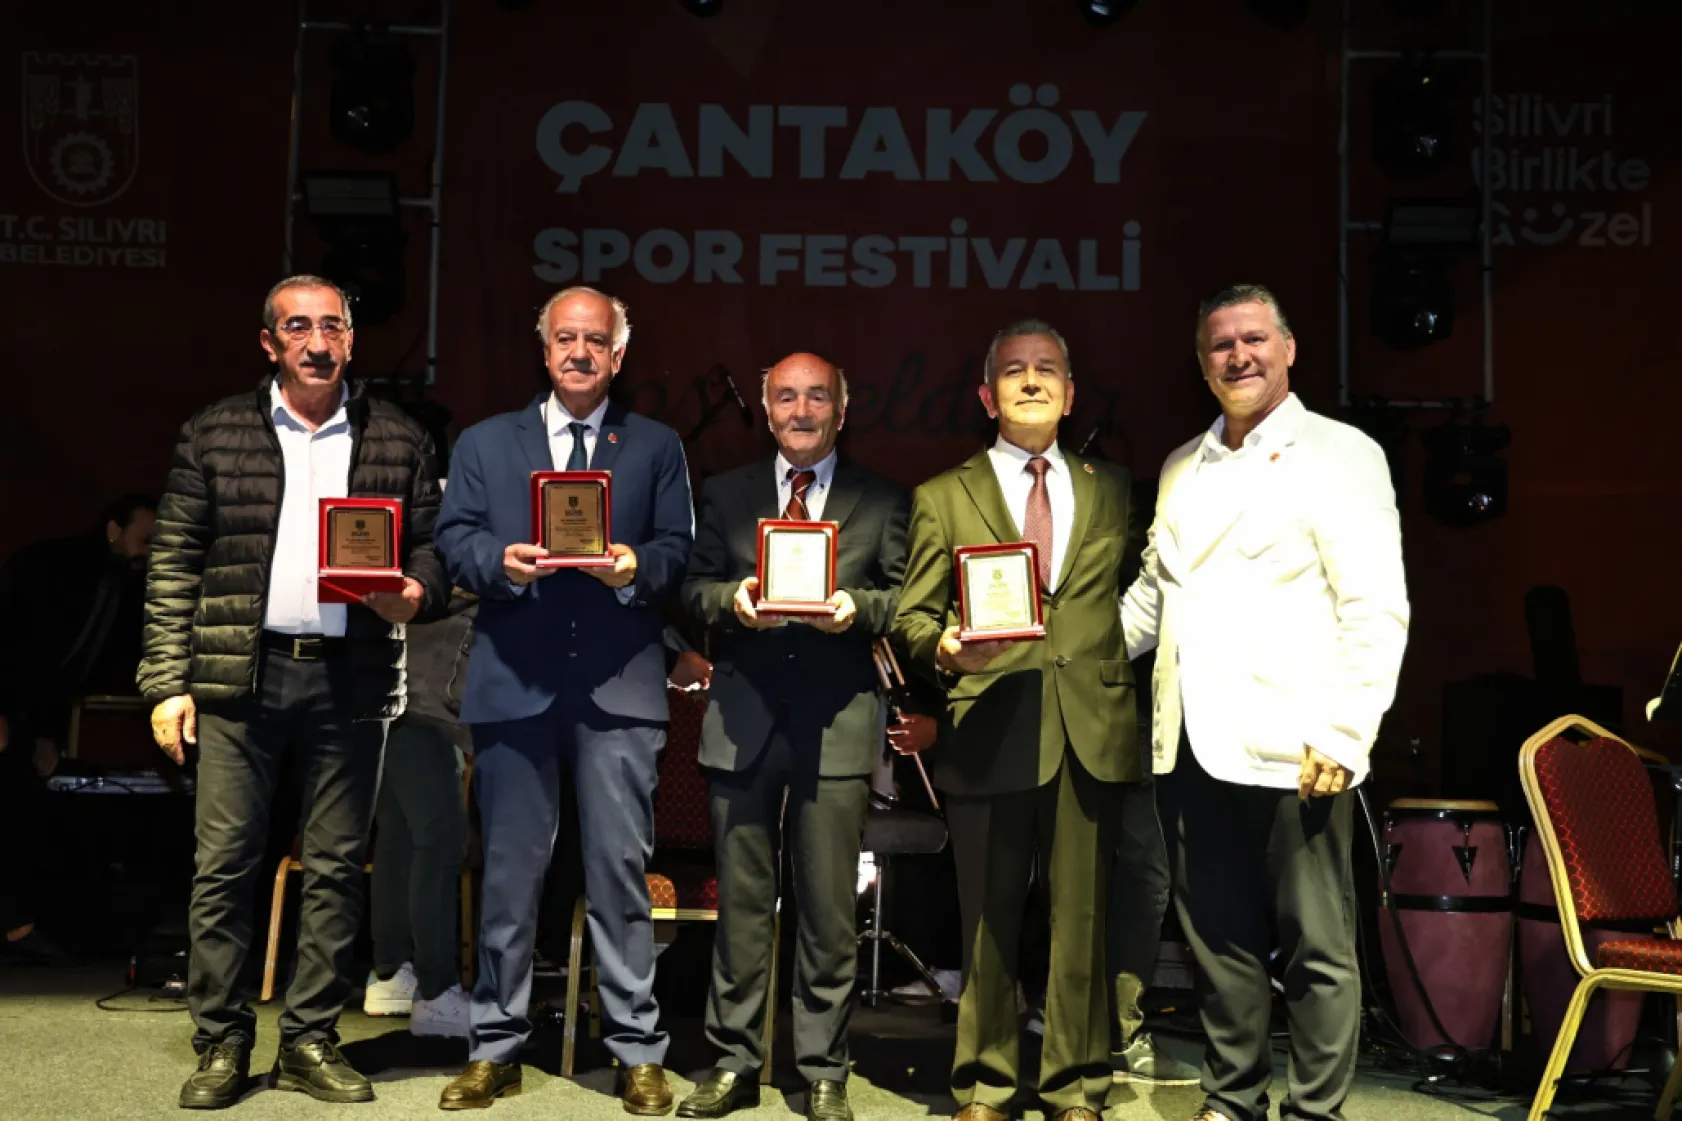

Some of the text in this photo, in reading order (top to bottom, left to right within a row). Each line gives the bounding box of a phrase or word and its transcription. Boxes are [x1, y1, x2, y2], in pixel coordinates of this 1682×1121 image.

[1472, 92, 1613, 137] Silivri
[535, 82, 1149, 195] ÇANTAKÖY
[1470, 145, 1651, 191] Birlikte
[0, 213, 53, 240] T.C.
[532, 217, 1142, 292] SPOR FESTİVALİ
